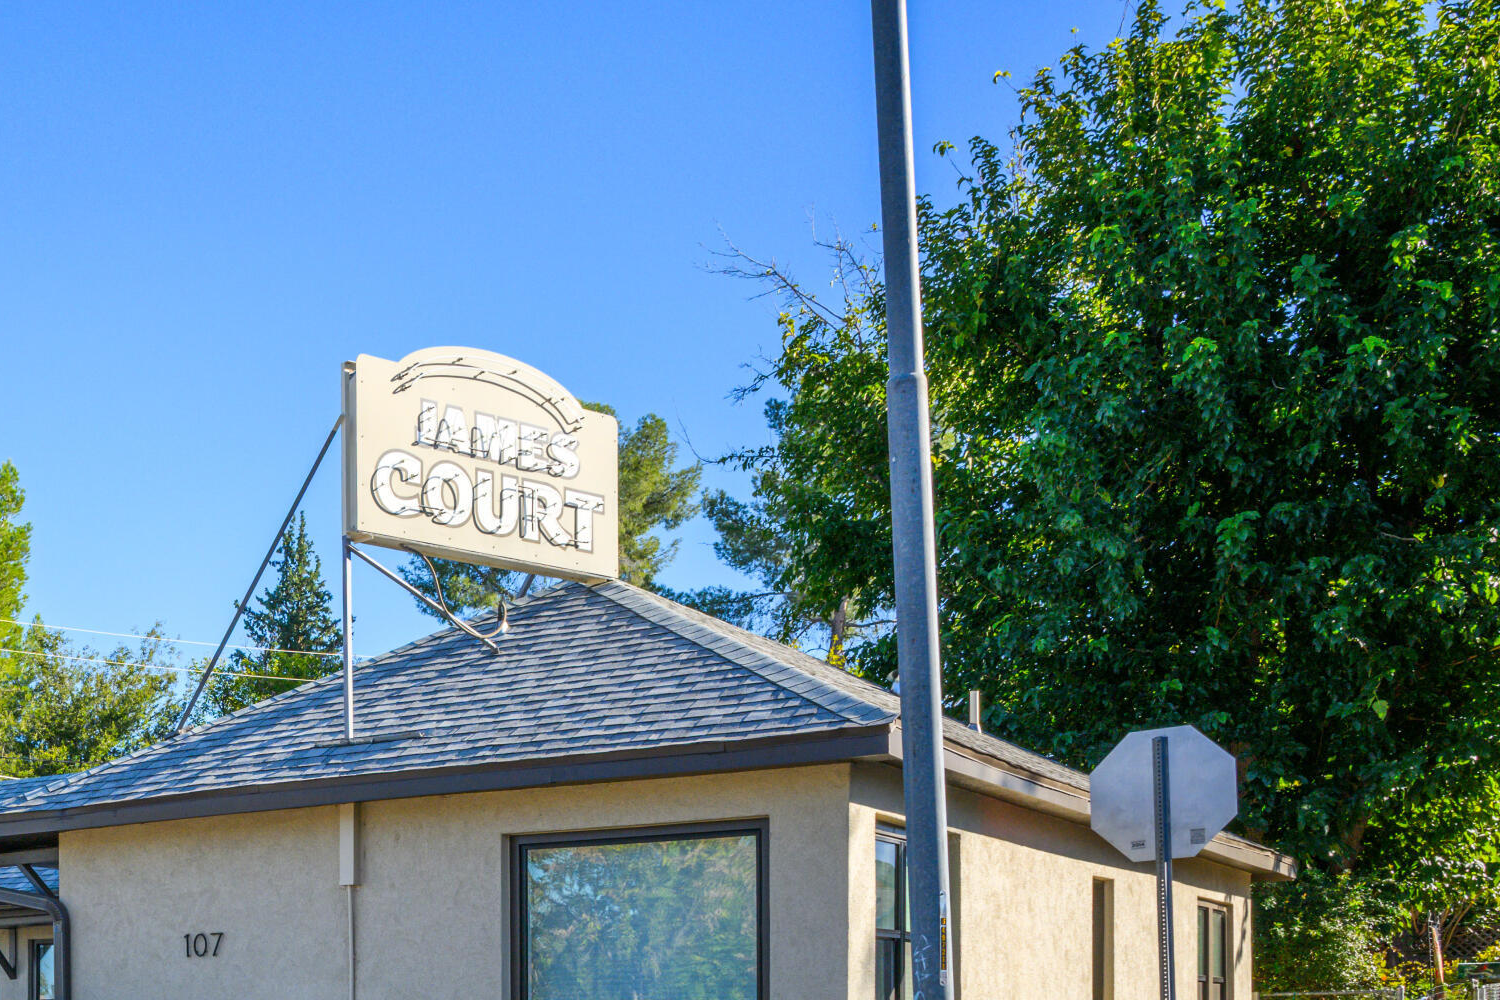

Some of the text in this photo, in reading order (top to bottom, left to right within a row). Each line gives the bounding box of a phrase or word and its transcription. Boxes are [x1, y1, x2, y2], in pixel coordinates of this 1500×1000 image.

[413, 398, 580, 479] JAMES
[371, 449, 605, 553] COURT
[184, 932, 224, 957] 107
